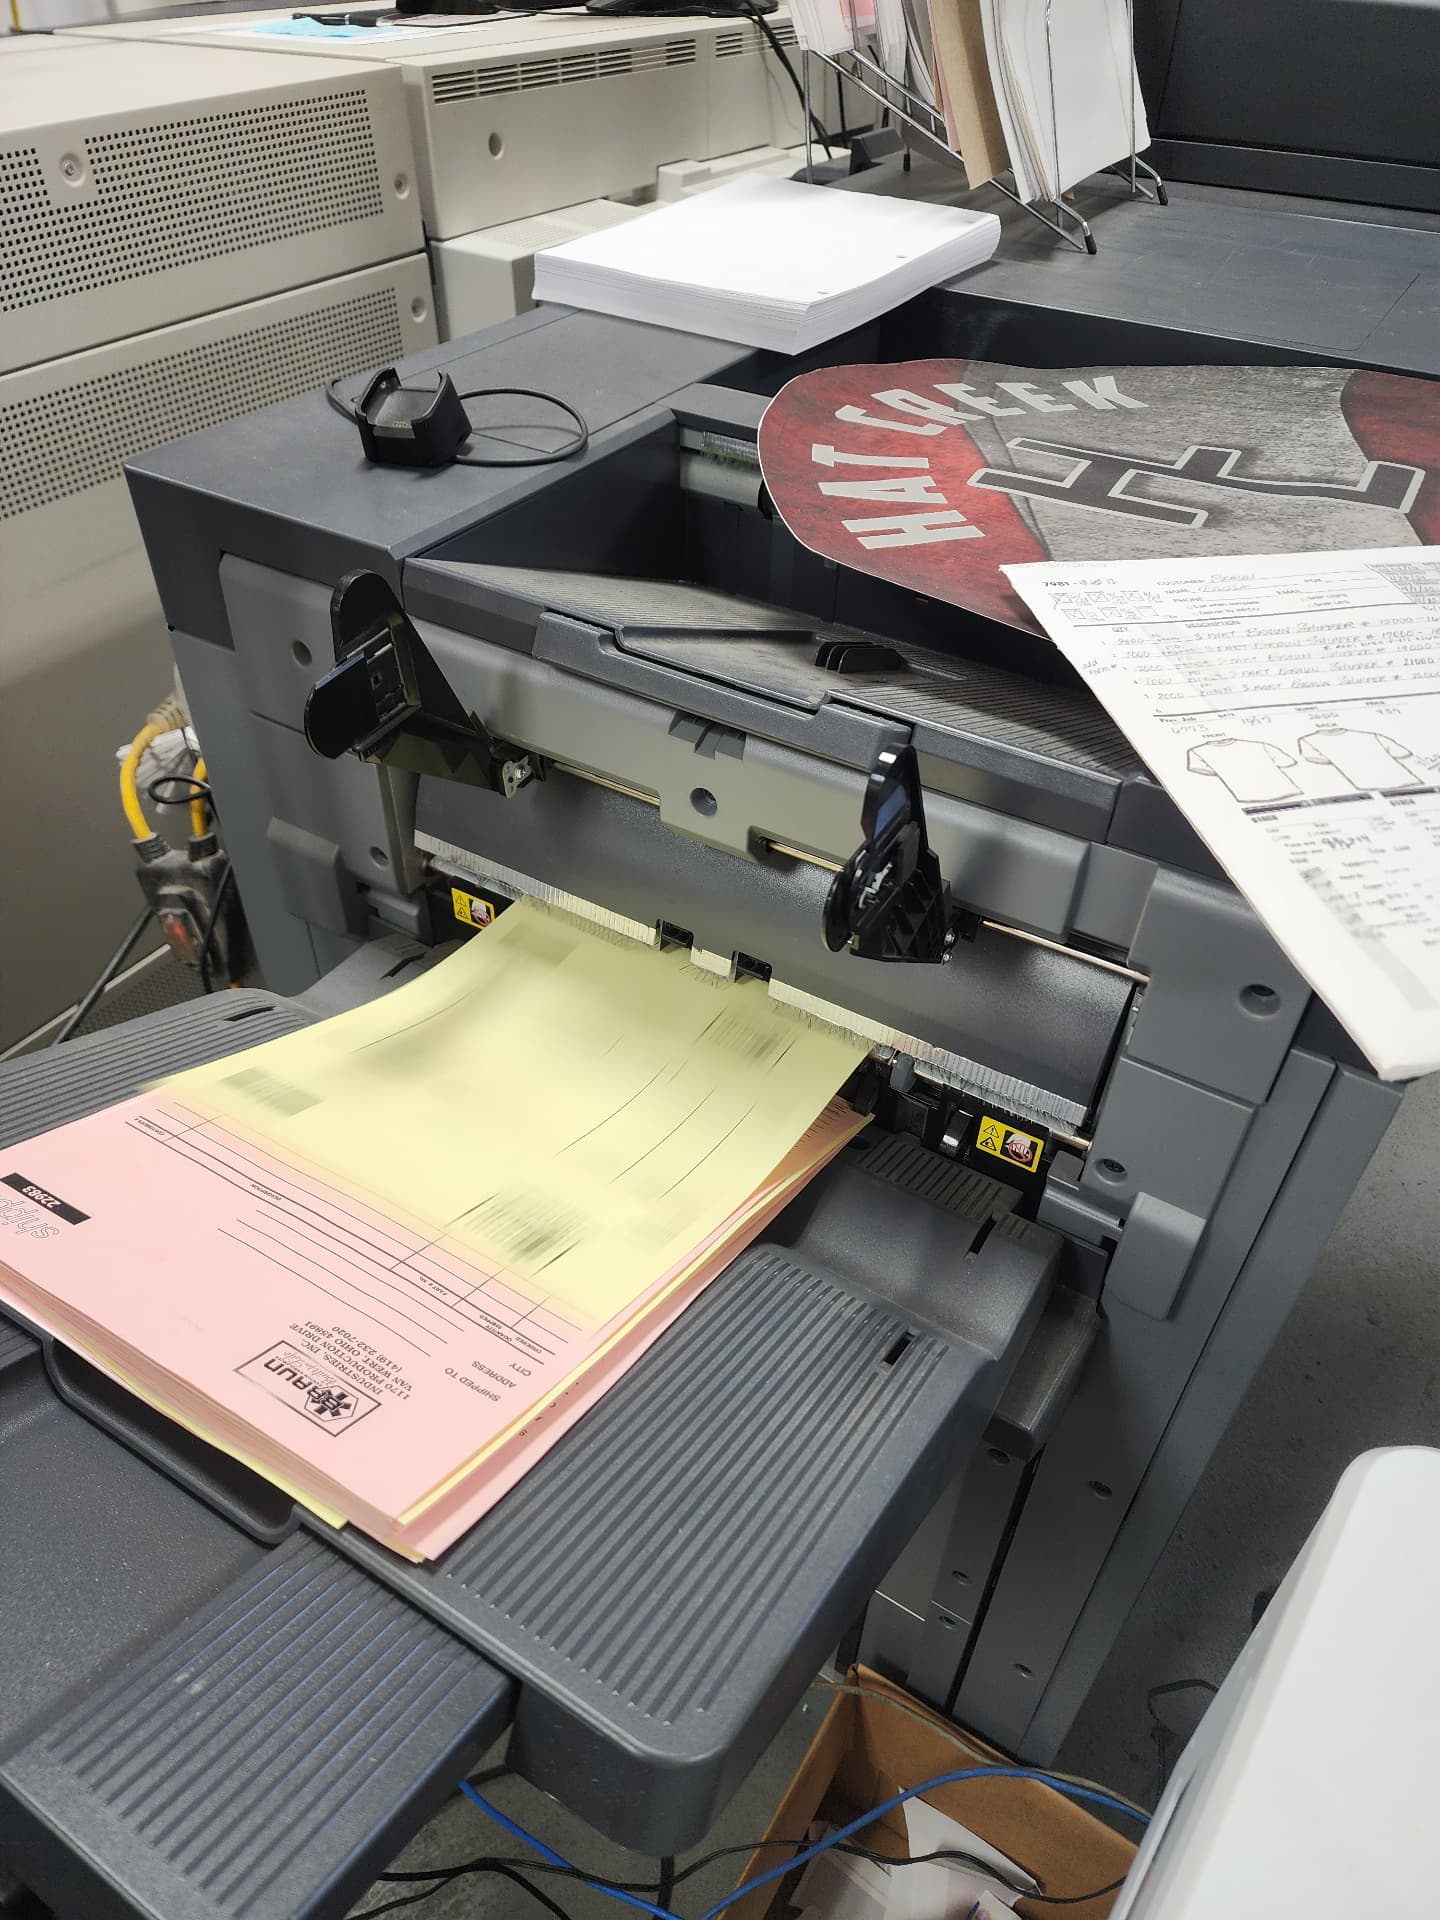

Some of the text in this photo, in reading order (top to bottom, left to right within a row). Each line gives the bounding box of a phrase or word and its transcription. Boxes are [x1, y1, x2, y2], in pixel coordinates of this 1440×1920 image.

[812, 375, 1150, 550] HAT CREEK
[22, 1185, 62, 1208] 22983
[332, 1326, 377, 1356] 232-7020
[334, 1338, 361, 1357] OHIO
[289, 1323, 411, 1400] 1170 PRODUCTION DRIVE
[471, 1360, 518, 1388] ADDRESS
[508, 1362, 532, 1377] CITY
[263, 1357, 342, 1412] BRAUN
[392, 1376, 413, 1392] VAN
[444, 1367, 502, 1402] SHIPPED TO
